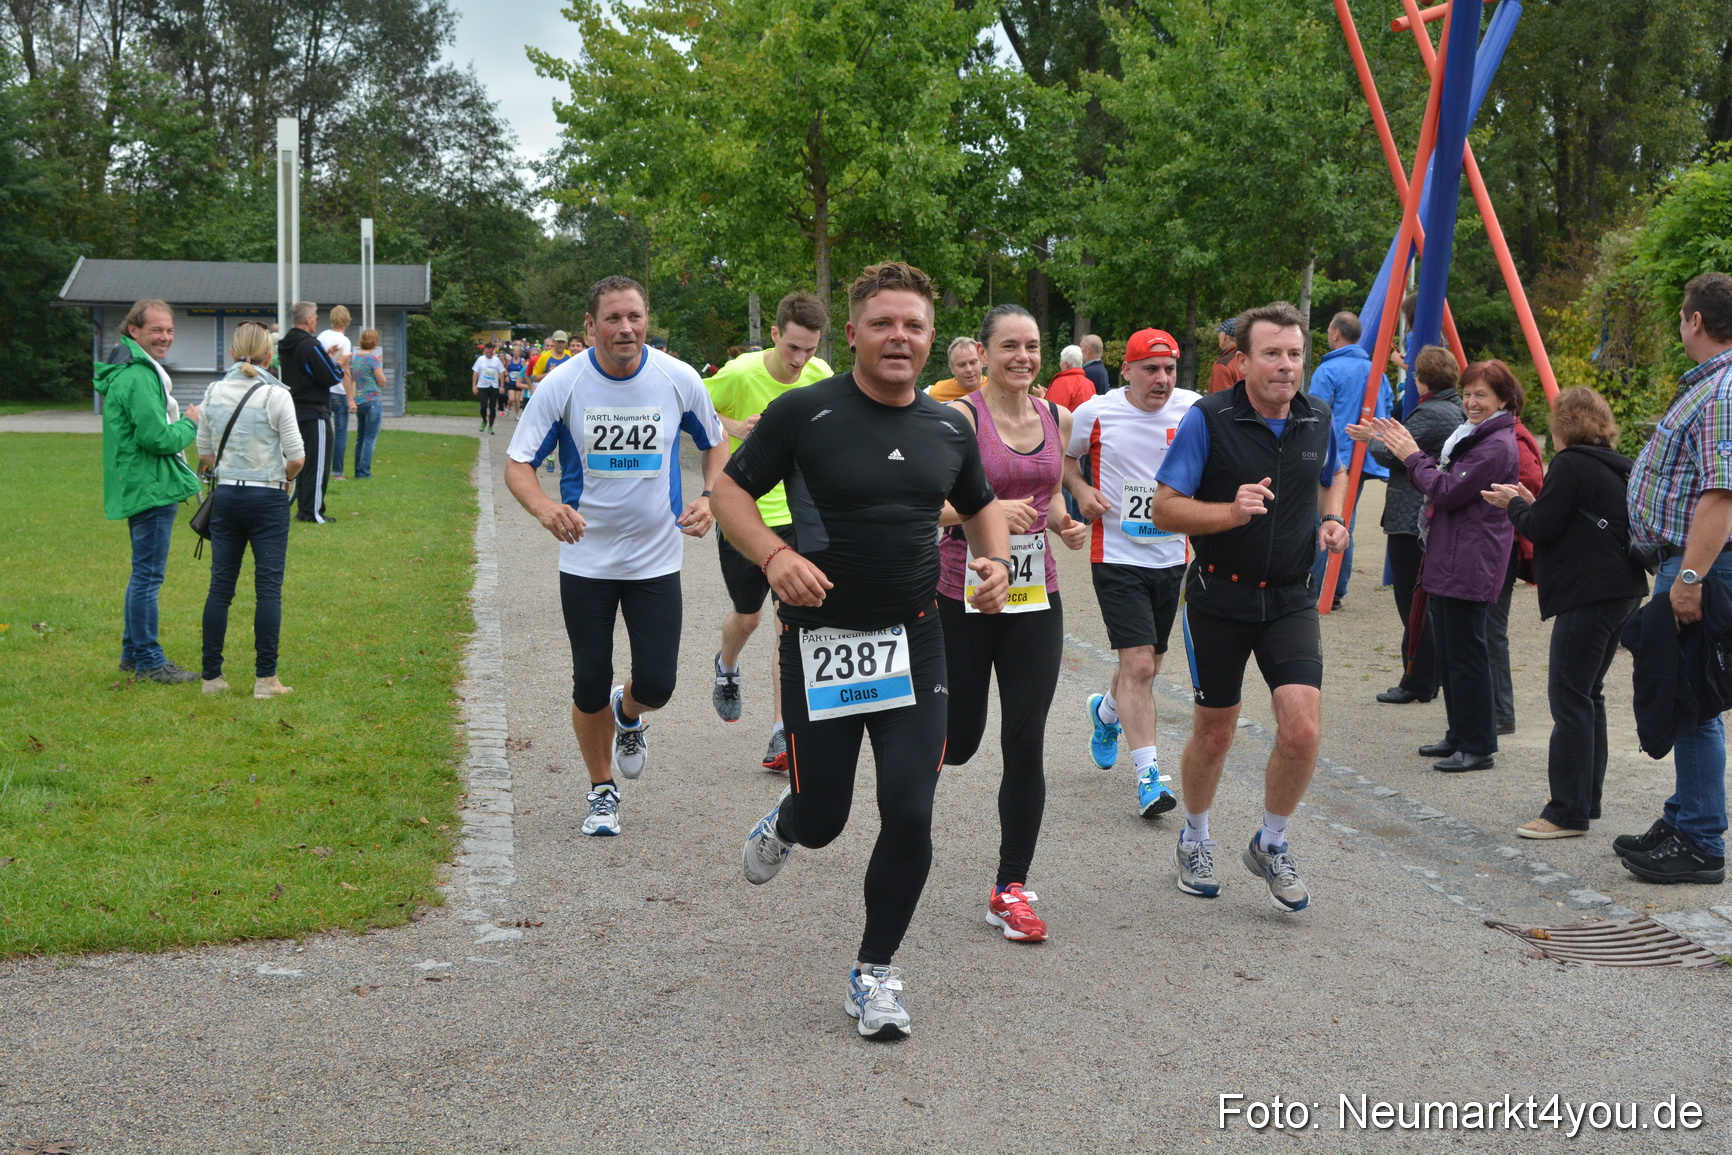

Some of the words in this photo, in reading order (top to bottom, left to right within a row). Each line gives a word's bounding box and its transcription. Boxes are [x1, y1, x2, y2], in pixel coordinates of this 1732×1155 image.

[593, 424, 657, 451] 2242
[610, 458, 639, 470] Ralph
[1124, 485, 1148, 493] PARTL
[1129, 495, 1153, 520] 28
[813, 640, 898, 682] 2387
[839, 688, 879, 703] Claus
